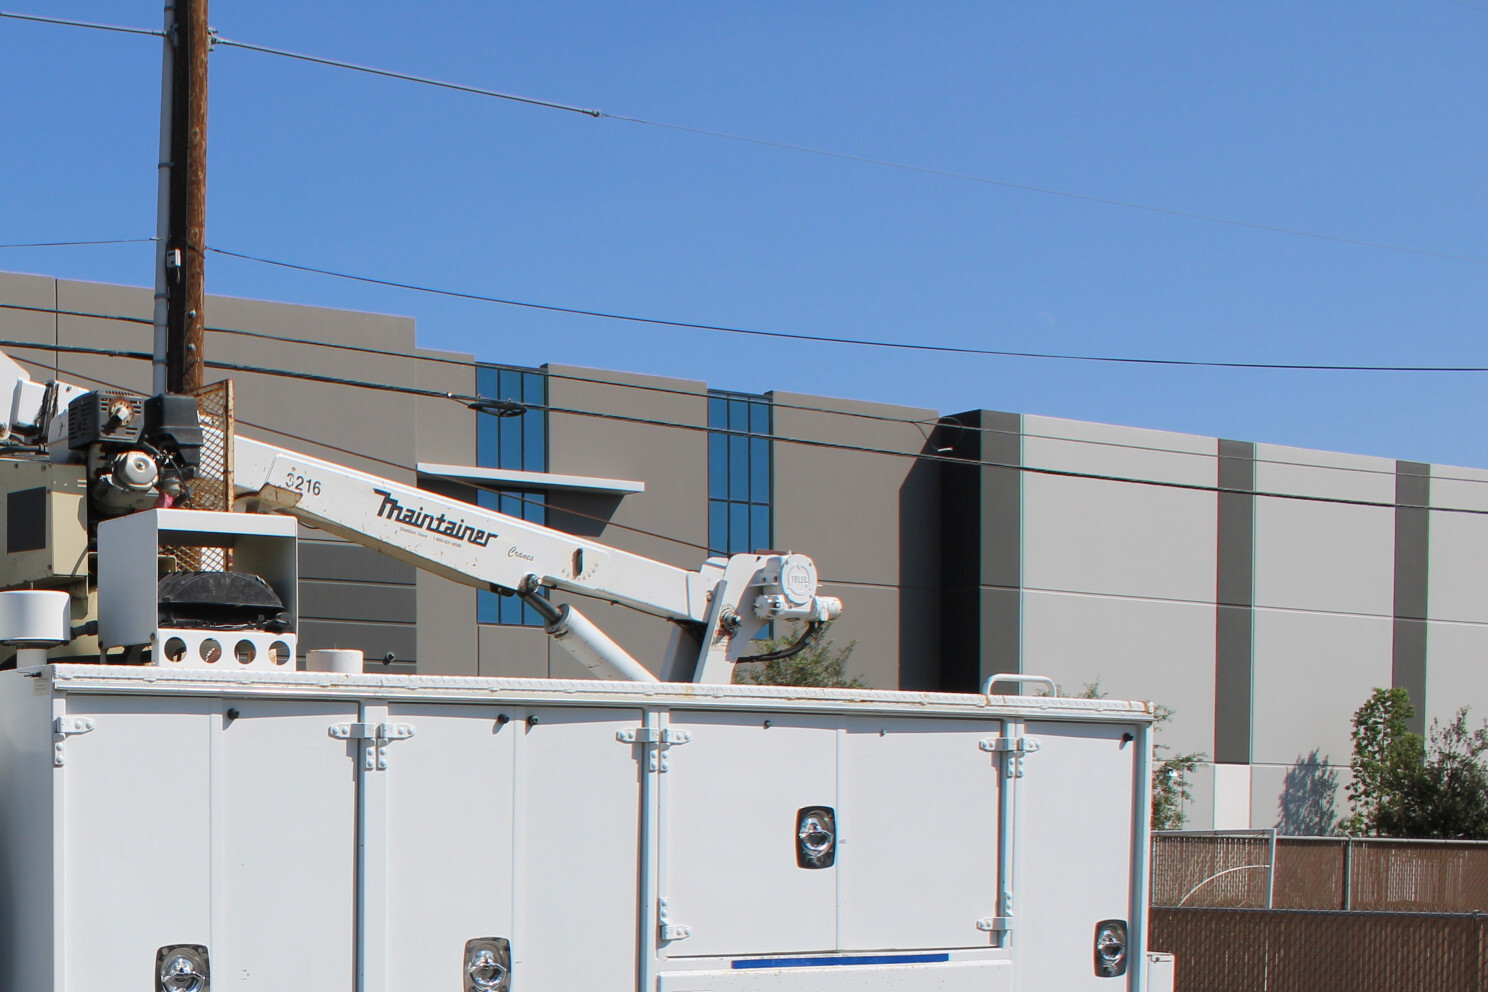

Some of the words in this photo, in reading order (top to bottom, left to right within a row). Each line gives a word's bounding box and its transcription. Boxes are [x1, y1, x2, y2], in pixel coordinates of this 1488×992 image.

[285, 472, 322, 496] 3216
[373, 488, 500, 548] Maintainer
[507, 546, 534, 562] Cranes
